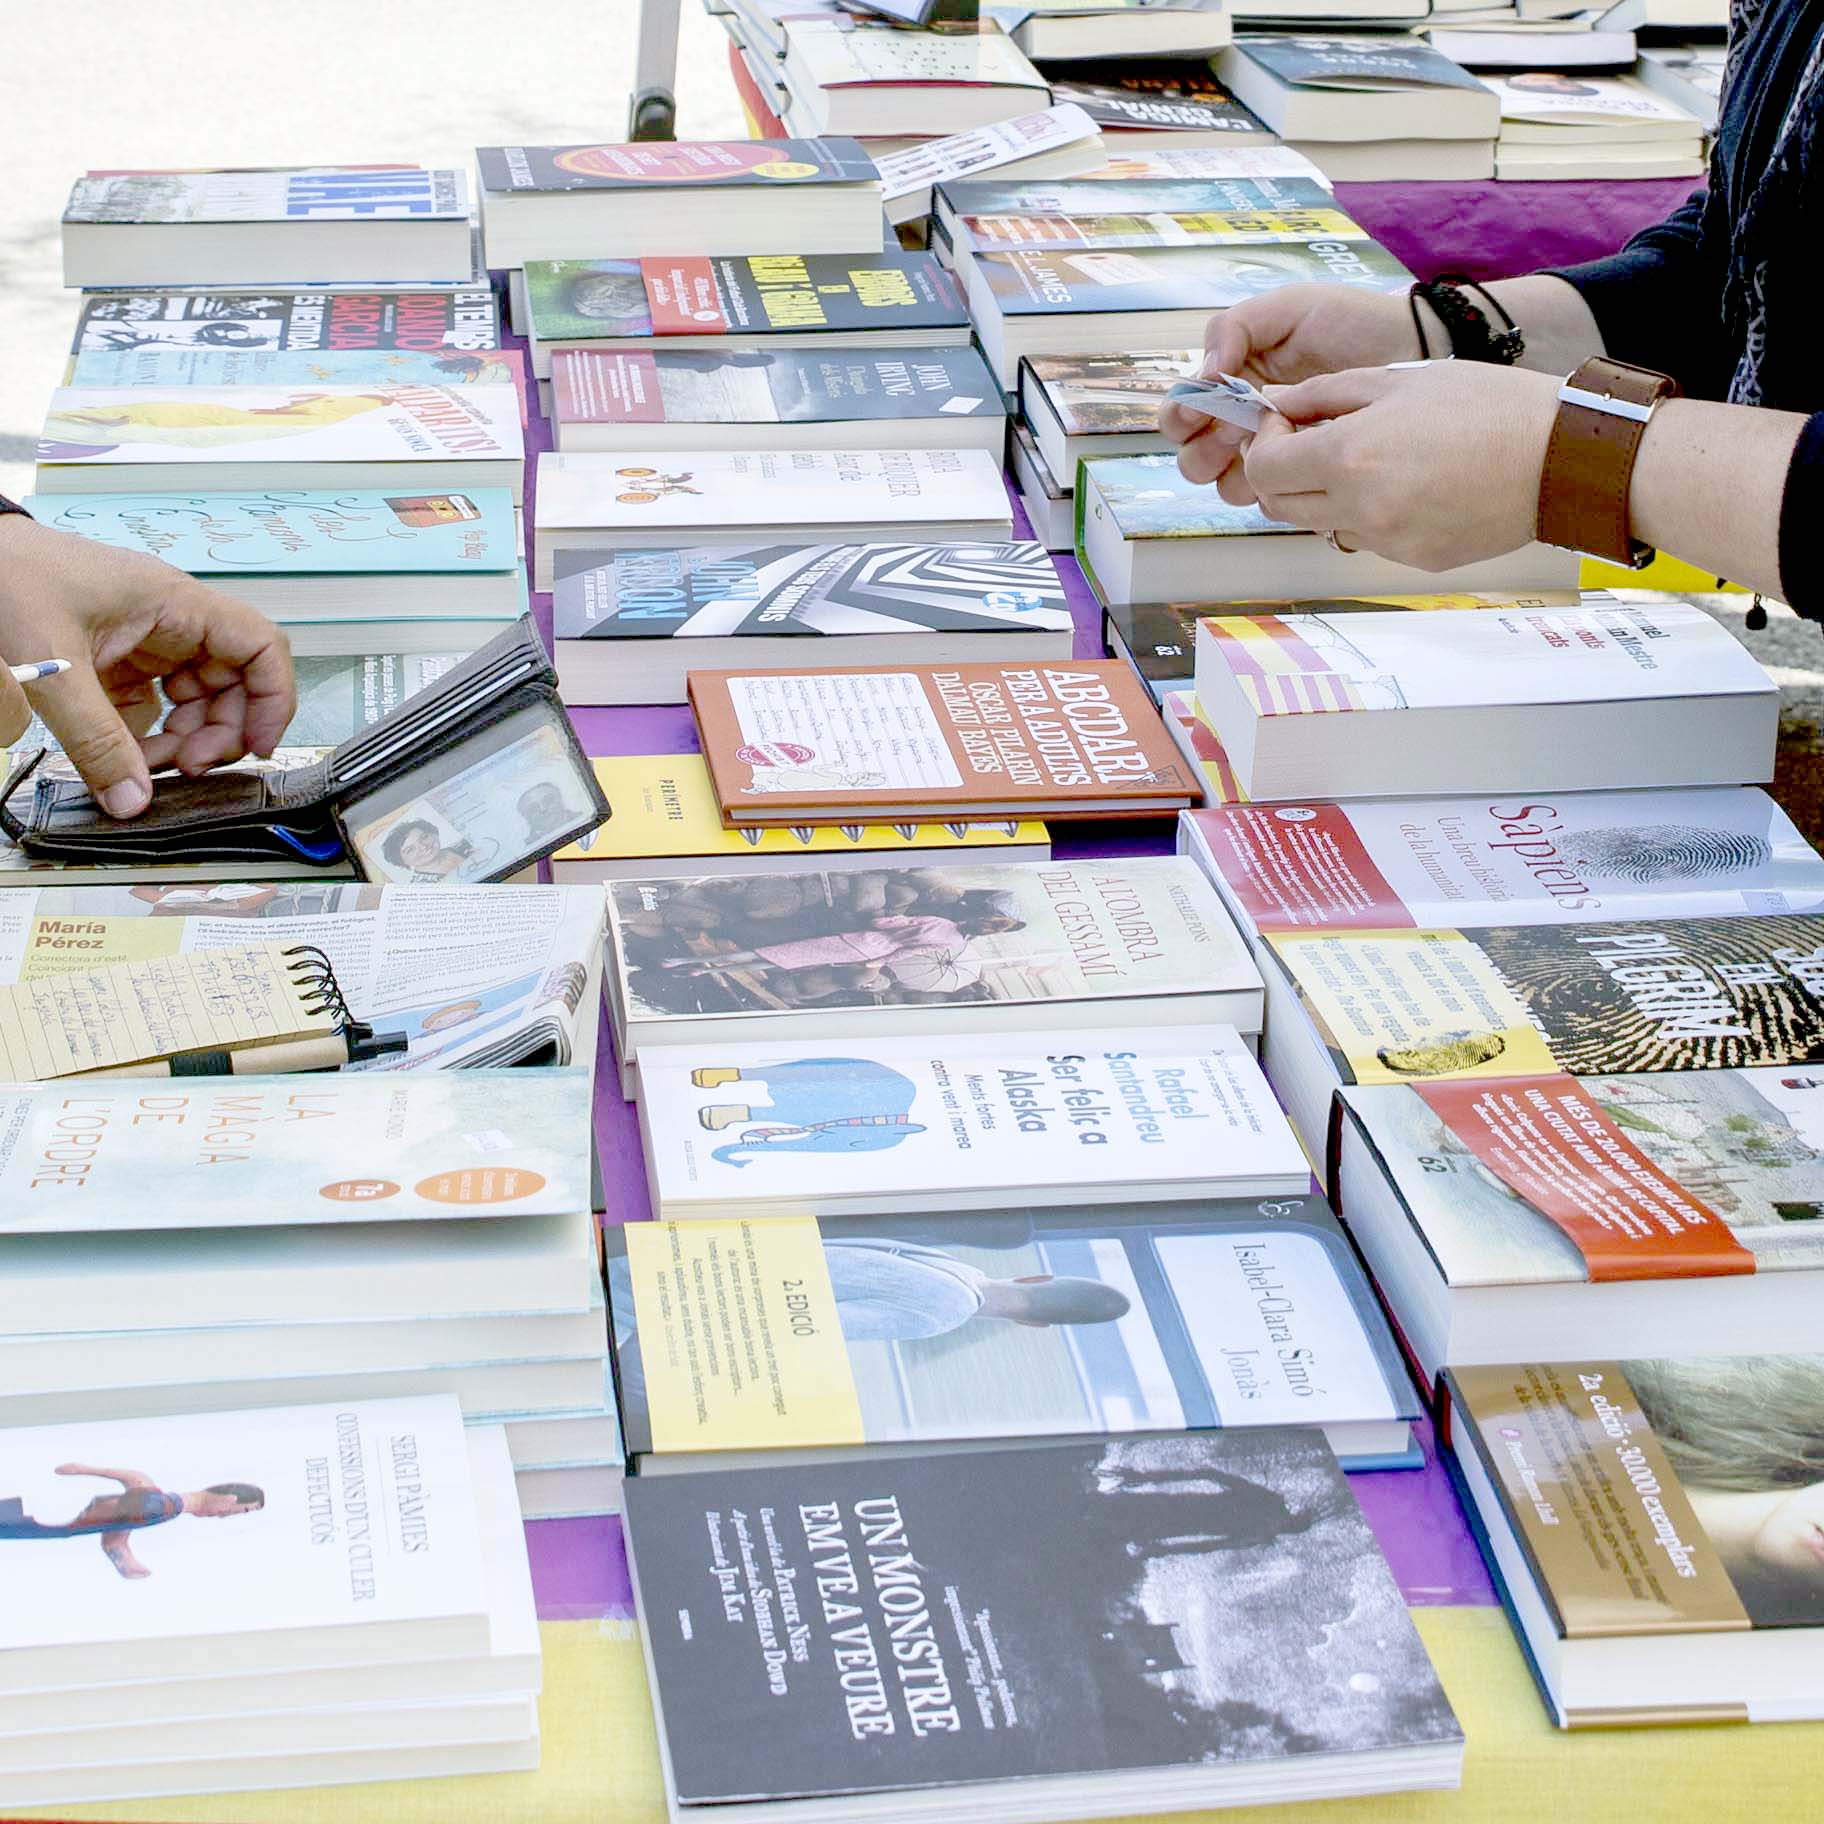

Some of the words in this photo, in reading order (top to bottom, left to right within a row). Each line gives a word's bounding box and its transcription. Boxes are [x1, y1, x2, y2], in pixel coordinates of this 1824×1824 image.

[1124, 108, 1254, 129] L'AMIGA
[747, 256, 810, 282] BLAU
[1308, 242, 1385, 286] GREY
[1029, 266, 1074, 304] JAMES
[761, 290, 827, 327] GRANA
[285, 305, 324, 351] MENTIDA
[451, 304, 496, 350] TEMPS
[874, 361, 916, 396] IRVING
[911, 364, 953, 391] JOHN
[690, 561, 760, 601] JOHN
[757, 586, 811, 622] SOMNIS
[1615, 637, 1659, 669] Mestre
[929, 672, 982, 724] DALMAU
[998, 670, 1047, 702] PER
[1015, 704, 1057, 720] A
[1041, 669, 1154, 784] ABCDARI
[1022, 719, 1093, 786] ADULTS
[656, 779, 684, 820] PERÍMETRE
[1398, 823, 1428, 838] de
[1409, 840, 1434, 850] la
[1436, 816, 1466, 840] Una
[1449, 843, 1485, 867] breu
[1487, 805, 1602, 910] Sàpiens
[1035, 871, 1083, 898] DEL
[1090, 877, 1127, 887] A
[1414, 852, 1468, 900] humanitat
[1472, 867, 1516, 902] història
[35, 936, 104, 949] Pérez
[38, 921, 107, 934] María
[1053, 902, 1127, 977] GESSAMÍ
[1097, 889, 1166, 963] L'OMBRA
[1185, 922, 1212, 943] PONS
[29, 955, 91, 963] Correctora
[1713, 963, 1786, 984] EN
[1573, 933, 1753, 1040] PILGRIM
[928, 1060, 958, 1086] contra
[1044, 1055, 1087, 1082] Ser
[938, 1090, 964, 1109] vent
[962, 1074, 991, 1100] Ments
[995, 1069, 1057, 1132] Alaska
[1101, 1052, 1166, 1144] Santandreu
[1150, 1068, 1210, 1119] Rafael
[1521, 1089, 1558, 1111] UNA
[131, 1097, 191, 1125] DE
[283, 1094, 340, 1122] LA
[971, 1103, 1000, 1130] fortes
[1059, 1089, 1111, 1126] feliç
[1556, 1096, 1605, 1119] MÉS
[29, 1098, 118, 1189] L'ORDRE
[194, 1096, 277, 1166] MÀGIA
[949, 1117, 975, 1149] marea
[1080, 1132, 1109, 1145] a
[1534, 1111, 1587, 1143] CIUTAT
[1577, 1121, 1612, 1136] DE
[1416, 1156, 1448, 1173] 62
[1563, 1144, 1605, 1163] AMB
[1589, 1137, 1641, 1170] 20.000
[352, 1183, 386, 1196] 7a
[1580, 1164, 1632, 1188] ÀNIMA
[1613, 1189, 1644, 1200] DE
[1628, 1171, 1707, 1225] EXEMPLARS
[1628, 1200, 1687, 1235] CAPITAL
[784, 1294, 817, 1336] EDICIÓ
[1230, 1243, 1298, 1342] Isabel-Clara
[1274, 1348, 1328, 1397] Simó
[1216, 1348, 1270, 1400] Jonàs
[1575, 1373, 1604, 1390] 2a
[1586, 1395, 1630, 1437] edició
[334, 1412, 371, 1500] CONFESSIONS
[389, 1435, 420, 1479] SERGI
[1501, 1441, 1535, 1469] Premi
[1610, 1446, 1661, 1496] 30.000
[303, 1456, 339, 1546] DEFECTUÓS
[340, 1500, 375, 1541] D'UN
[393, 1485, 431, 1553] PÀMIES
[797, 1501, 848, 1552] EM
[854, 1495, 908, 1547] UN
[1637, 1496, 1700, 1578] exemplars
[344, 1544, 377, 1602] CULER
[813, 1553, 859, 1599] VE
[821, 1600, 863, 1624] A
[867, 1552, 960, 1737] MONSTRE
[829, 1623, 895, 1740] VEURE
